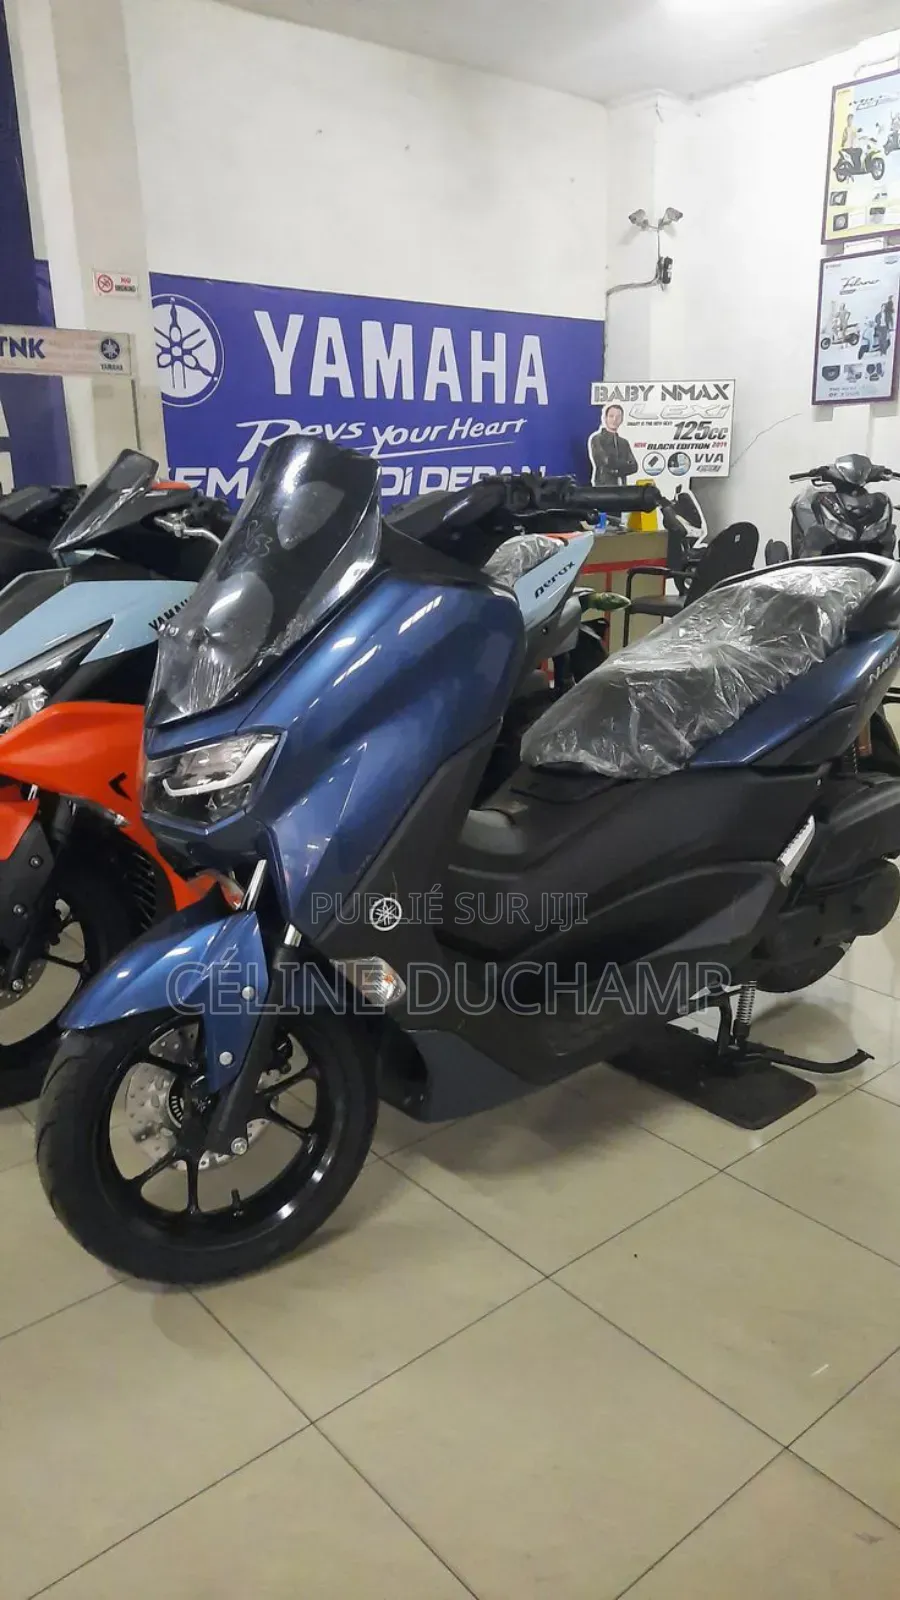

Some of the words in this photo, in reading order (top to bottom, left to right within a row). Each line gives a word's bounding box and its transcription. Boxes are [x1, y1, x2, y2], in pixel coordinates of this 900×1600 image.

[253, 309, 549, 406] YAMAHA
[593, 384, 655, 402] BABY
[661, 383, 730, 402] NMAX
[370, 424, 447, 459] your
[448, 417, 528, 440] Heart
[676, 442, 711, 450] EDITION
[694, 453, 724, 463] VVA
